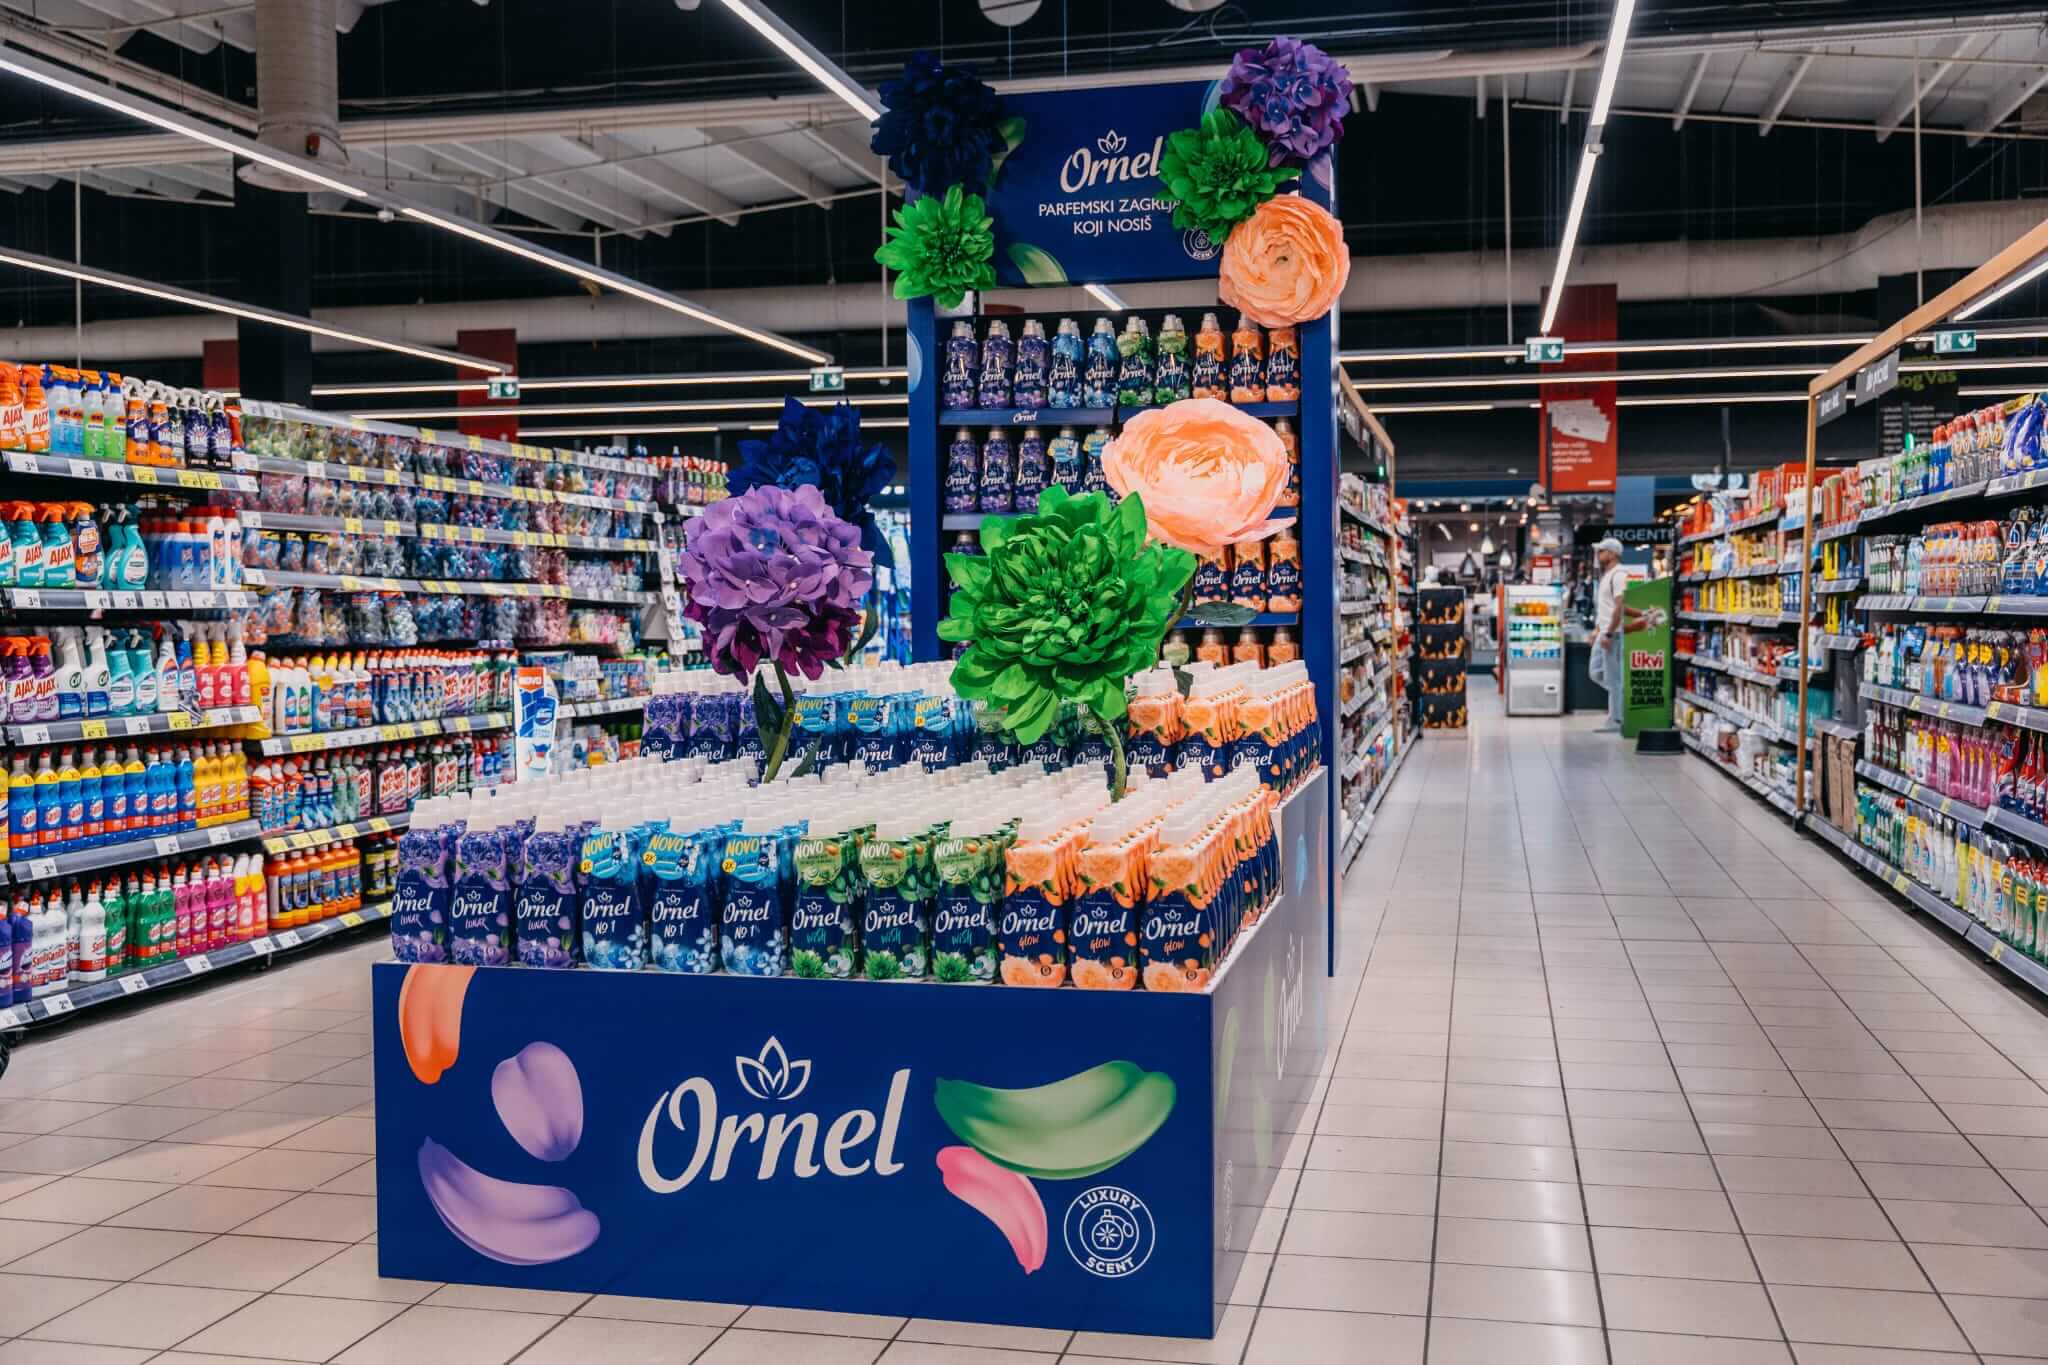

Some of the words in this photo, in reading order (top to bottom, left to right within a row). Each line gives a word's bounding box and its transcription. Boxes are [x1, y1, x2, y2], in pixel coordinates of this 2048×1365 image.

[1059, 135, 1164, 193] Ornel
[1038, 201, 1114, 216] PARFEMSKI
[1073, 219, 1103, 237] KOJI
[1107, 214, 1152, 233] NOSIŠ
[3, 406, 24, 425] AJAX
[33, 409, 49, 429] AJAX
[49, 545, 72, 566] AJAX
[1195, 574, 1223, 587] Ornel
[1233, 572, 1261, 587] Ornel
[1270, 572, 1299, 585] Ornel
[1631, 650, 1664, 668] Likvi
[15, 679, 34, 698] AJAX
[36, 678, 56, 697] AJAX
[851, 700, 877, 711] NOVO
[915, 698, 941, 713] NOVO
[583, 834, 612, 857] NOVO
[649, 835, 684, 852] NOVO
[726, 839, 760, 857] NOVO
[795, 840, 824, 858] NOVO
[861, 841, 890, 858] NOVO
[935, 839, 964, 857] NOVO
[391, 890, 433, 914] Ornel
[452, 895, 499, 918] Ornel
[517, 897, 563, 919] Ornel
[583, 895, 631, 920] Ornel
[652, 899, 700, 922] Ornel
[723, 900, 771, 924] Ornel
[792, 905, 840, 930] Ornel
[865, 904, 914, 932] Ornel
[935, 904, 986, 933] Ornel
[1002, 908, 1056, 935] Ornel
[1073, 912, 1127, 937] Ornel
[1146, 912, 1201, 940] Ornel
[1018, 934, 1040, 950] glow
[1090, 936, 1111, 953] glow
[1163, 939, 1185, 955] glow
[636, 1067, 912, 1194] Ornel
[1079, 1189, 1140, 1211] LUXURY
[1085, 1256, 1135, 1274] SCENT
